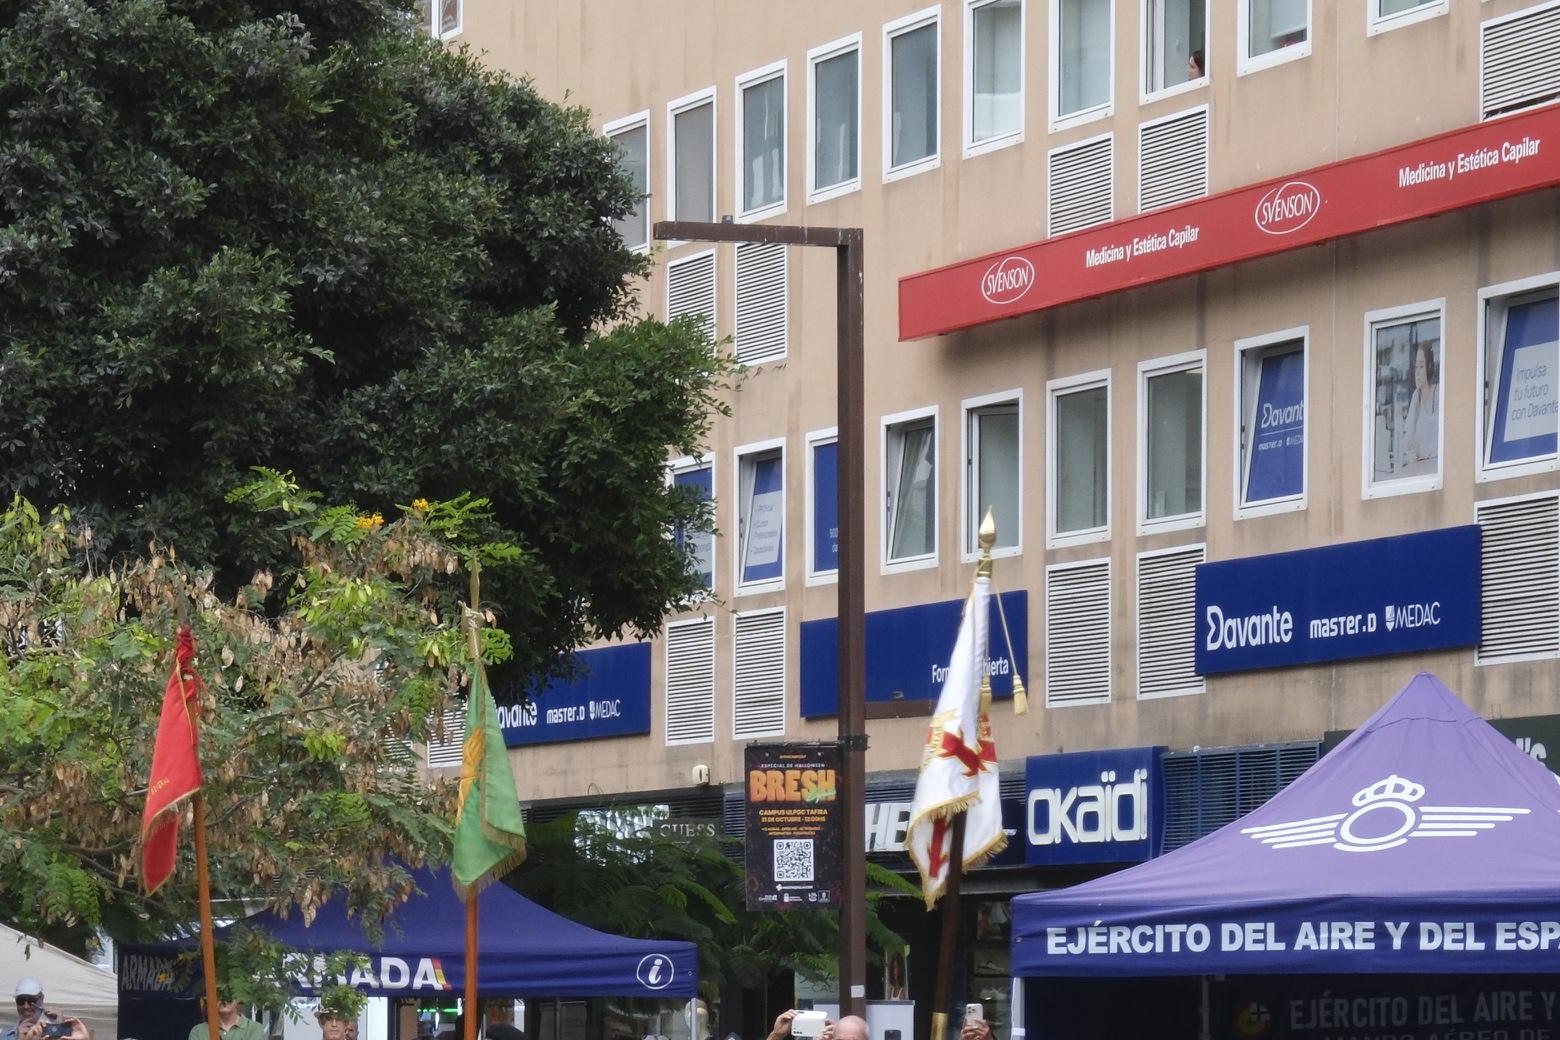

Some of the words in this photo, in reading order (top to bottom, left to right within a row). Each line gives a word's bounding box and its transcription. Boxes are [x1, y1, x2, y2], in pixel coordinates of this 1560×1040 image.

[1399, 163, 1446, 188] Medicina
[1448, 162, 1456, 180] y
[1457, 147, 1498, 174] Estética
[1502, 137, 1540, 164] Capilar
[1261, 190, 1313, 225] SVENSON
[1086, 244, 1124, 268] Medicina
[1125, 246, 1132, 261] y
[1133, 232, 1167, 257] Estética
[1168, 223, 1200, 249] Capilar
[986, 267, 1030, 296] SVENSON
[1516, 361, 1548, 382] Impulsa
[1514, 386, 1524, 401] tu
[1524, 383, 1549, 400] futuro
[1511, 408, 1526, 421] con
[1206, 604, 1293, 651] Davante
[1395, 601, 1441, 629] MEDAC
[496, 702, 538, 729] avante
[594, 699, 621, 719] MEDAC
[749, 769, 836, 802] BRESH
[1046, 920, 1211, 955] EJÉRCITO
[1221, 922, 1286, 951] DEL
[1293, 921, 1376, 951] AIRE
[1383, 921, 1410, 950] Y
[1419, 921, 1486, 951] DEL
[1495, 921, 1560, 951] ESP
[1289, 990, 1408, 1030] EJÉRCITO
[1417, 994, 1465, 1025] DEL
[1472, 990, 1534, 1022] AIRE
[1540, 991, 1557, 1020] Y
